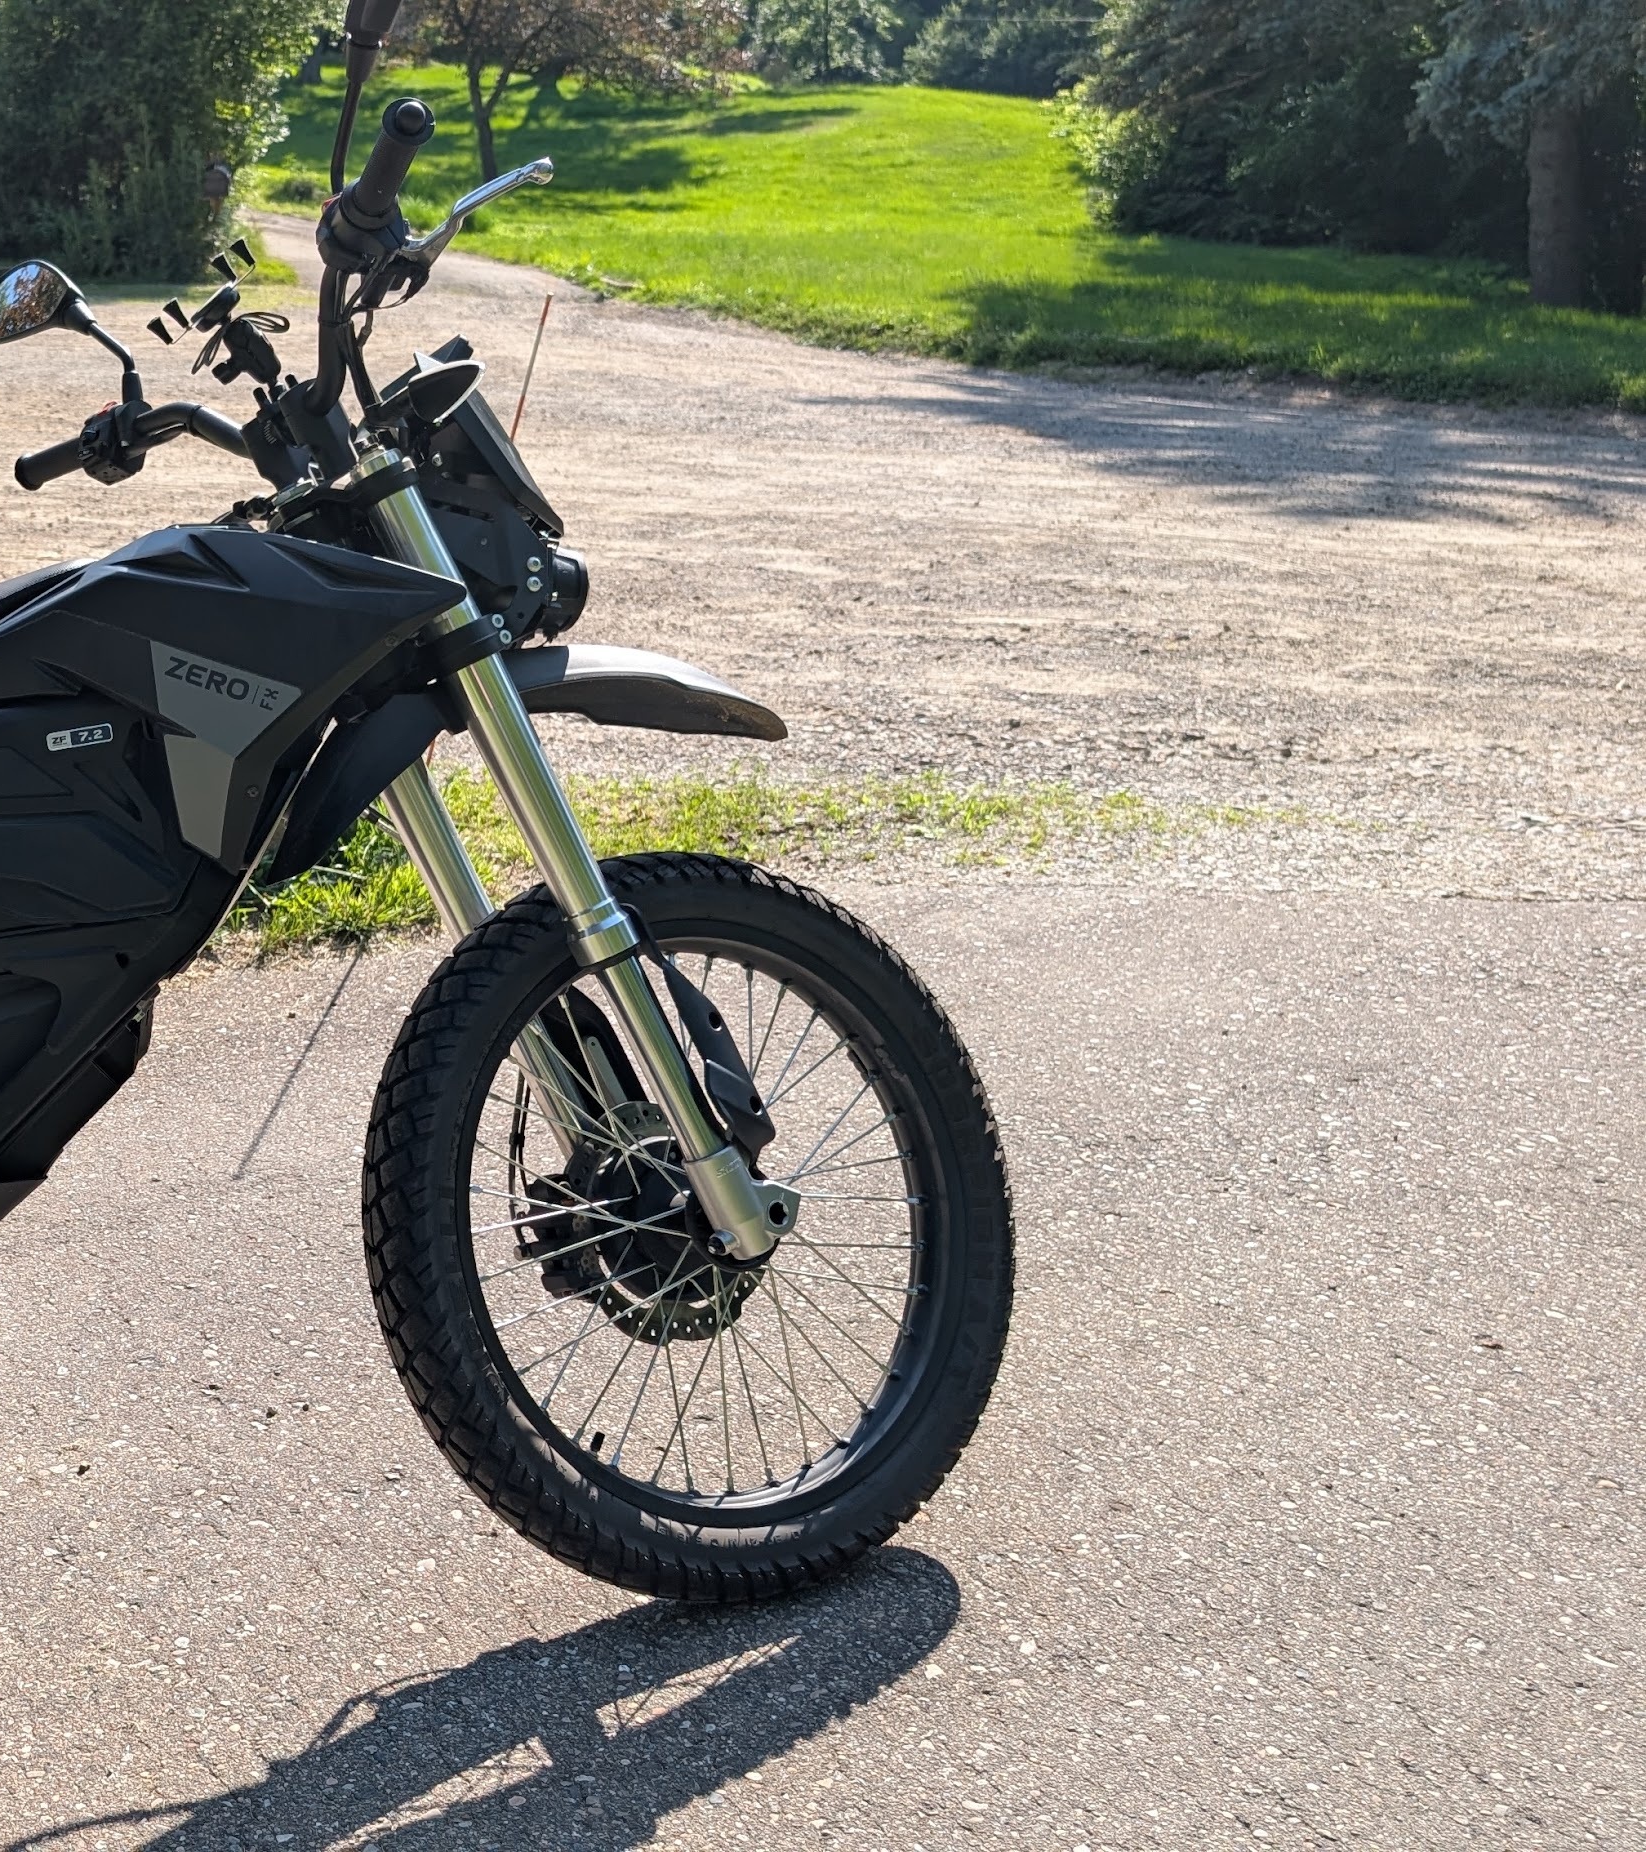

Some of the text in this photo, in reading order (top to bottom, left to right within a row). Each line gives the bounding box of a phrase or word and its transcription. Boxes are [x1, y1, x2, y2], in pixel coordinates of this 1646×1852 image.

[164, 656, 279, 711] ZERO FX
[51, 729, 104, 745] ZF 7.2
